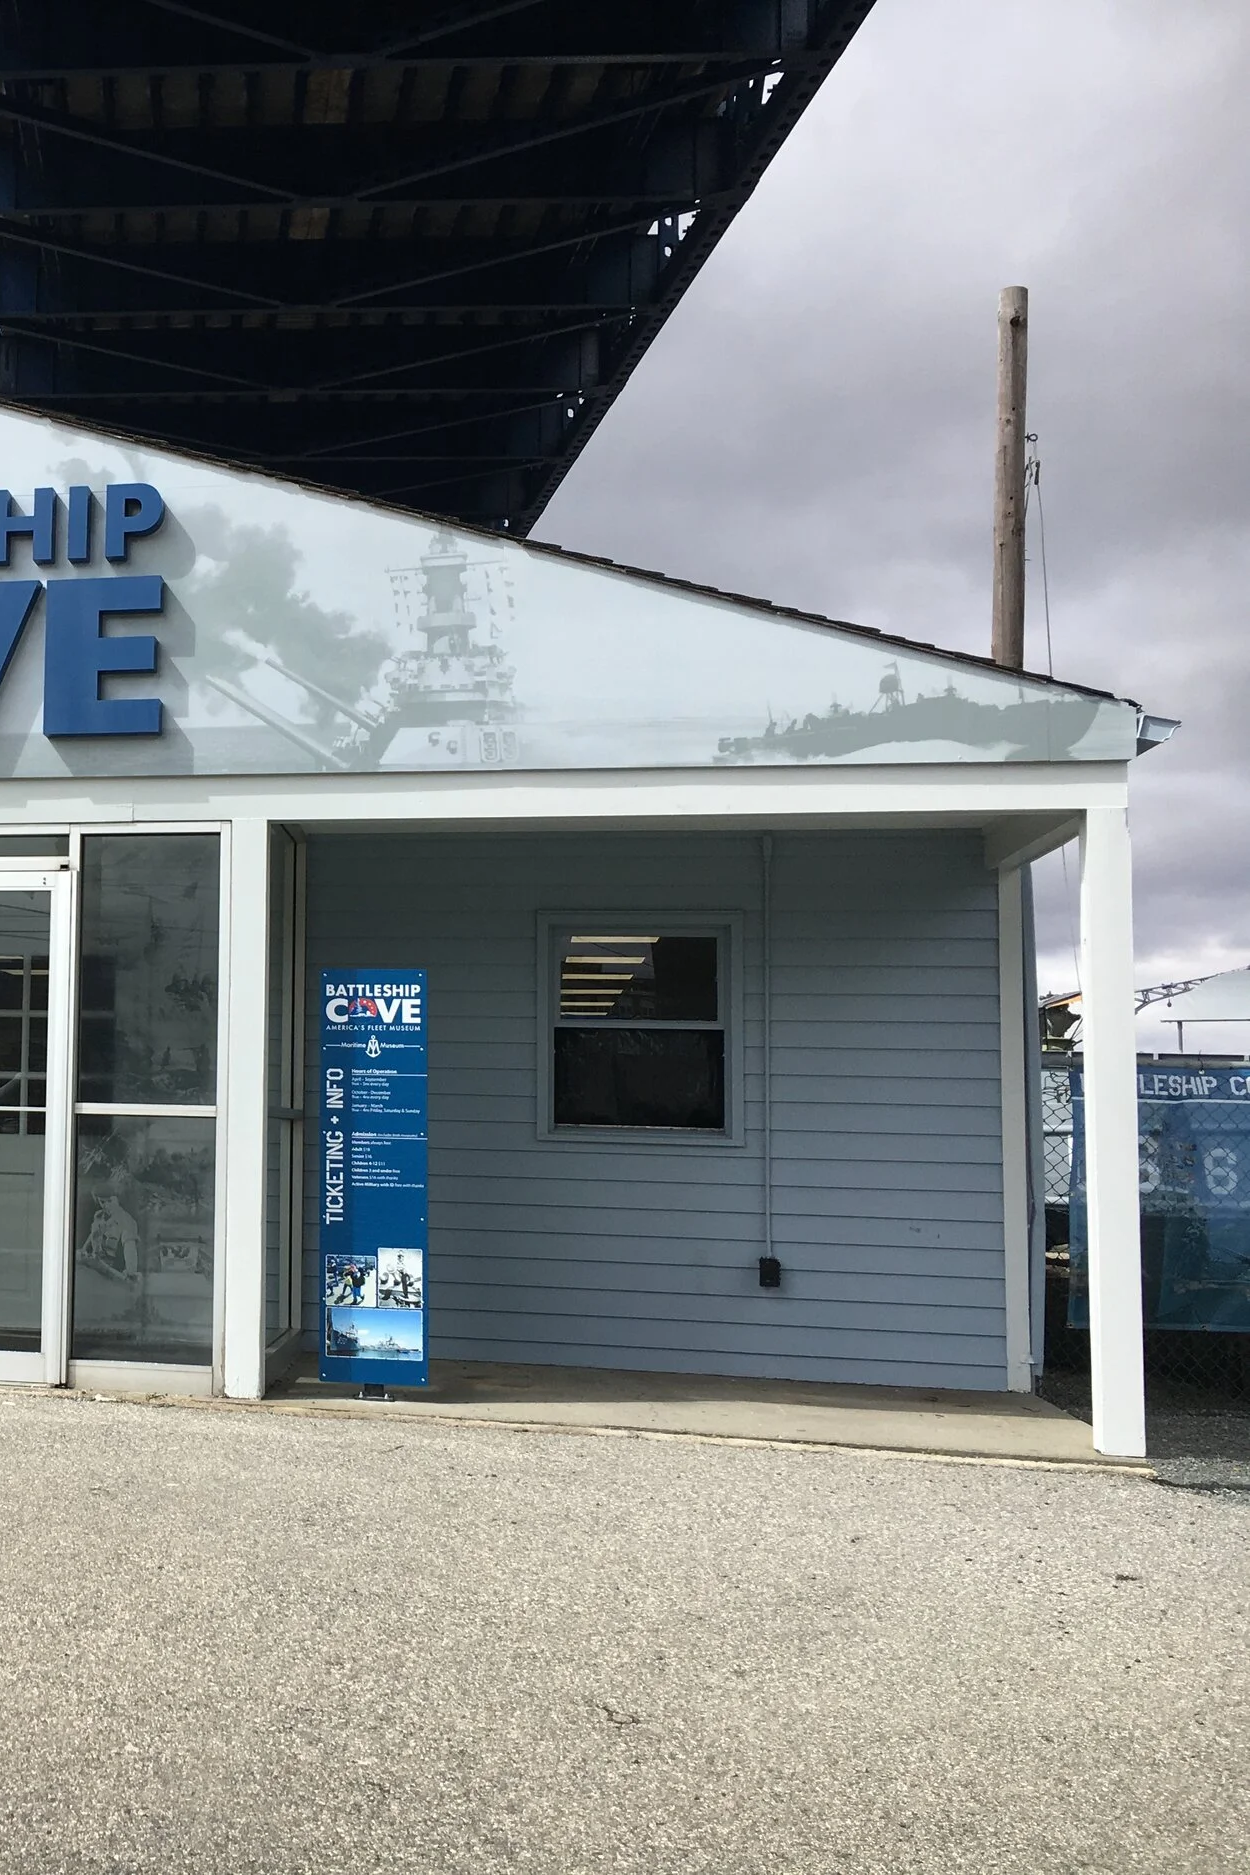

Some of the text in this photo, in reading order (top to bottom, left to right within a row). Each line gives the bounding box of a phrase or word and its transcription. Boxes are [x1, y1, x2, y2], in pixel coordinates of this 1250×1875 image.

[325, 984, 421, 997] BATTLESHIP
[325, 997, 421, 1023] COVE
[326, 1068, 344, 1108] INFO
[326, 1131, 344, 1225] TICKETING
